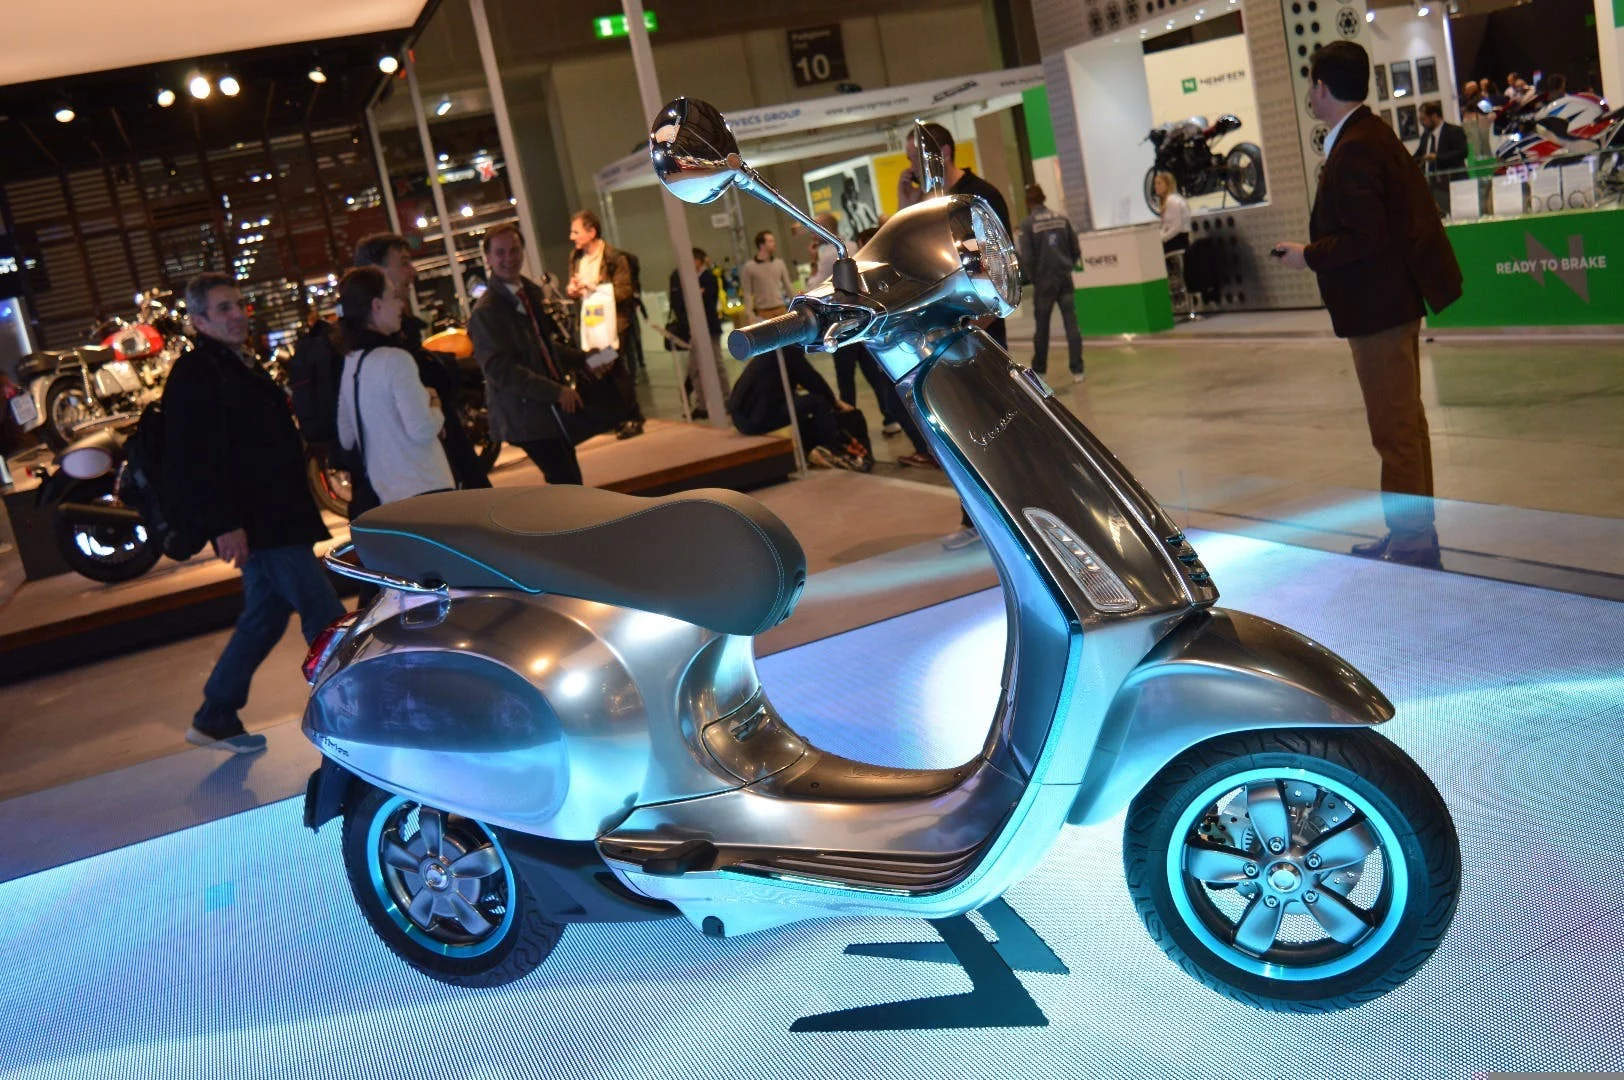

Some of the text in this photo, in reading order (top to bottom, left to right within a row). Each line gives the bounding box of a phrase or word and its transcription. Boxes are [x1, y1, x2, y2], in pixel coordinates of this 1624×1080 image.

[796, 54, 830, 82] 10
[724, 107, 802, 127] OVECS GROUP
[1495, 255, 1607, 275] READY TO BRAKE
